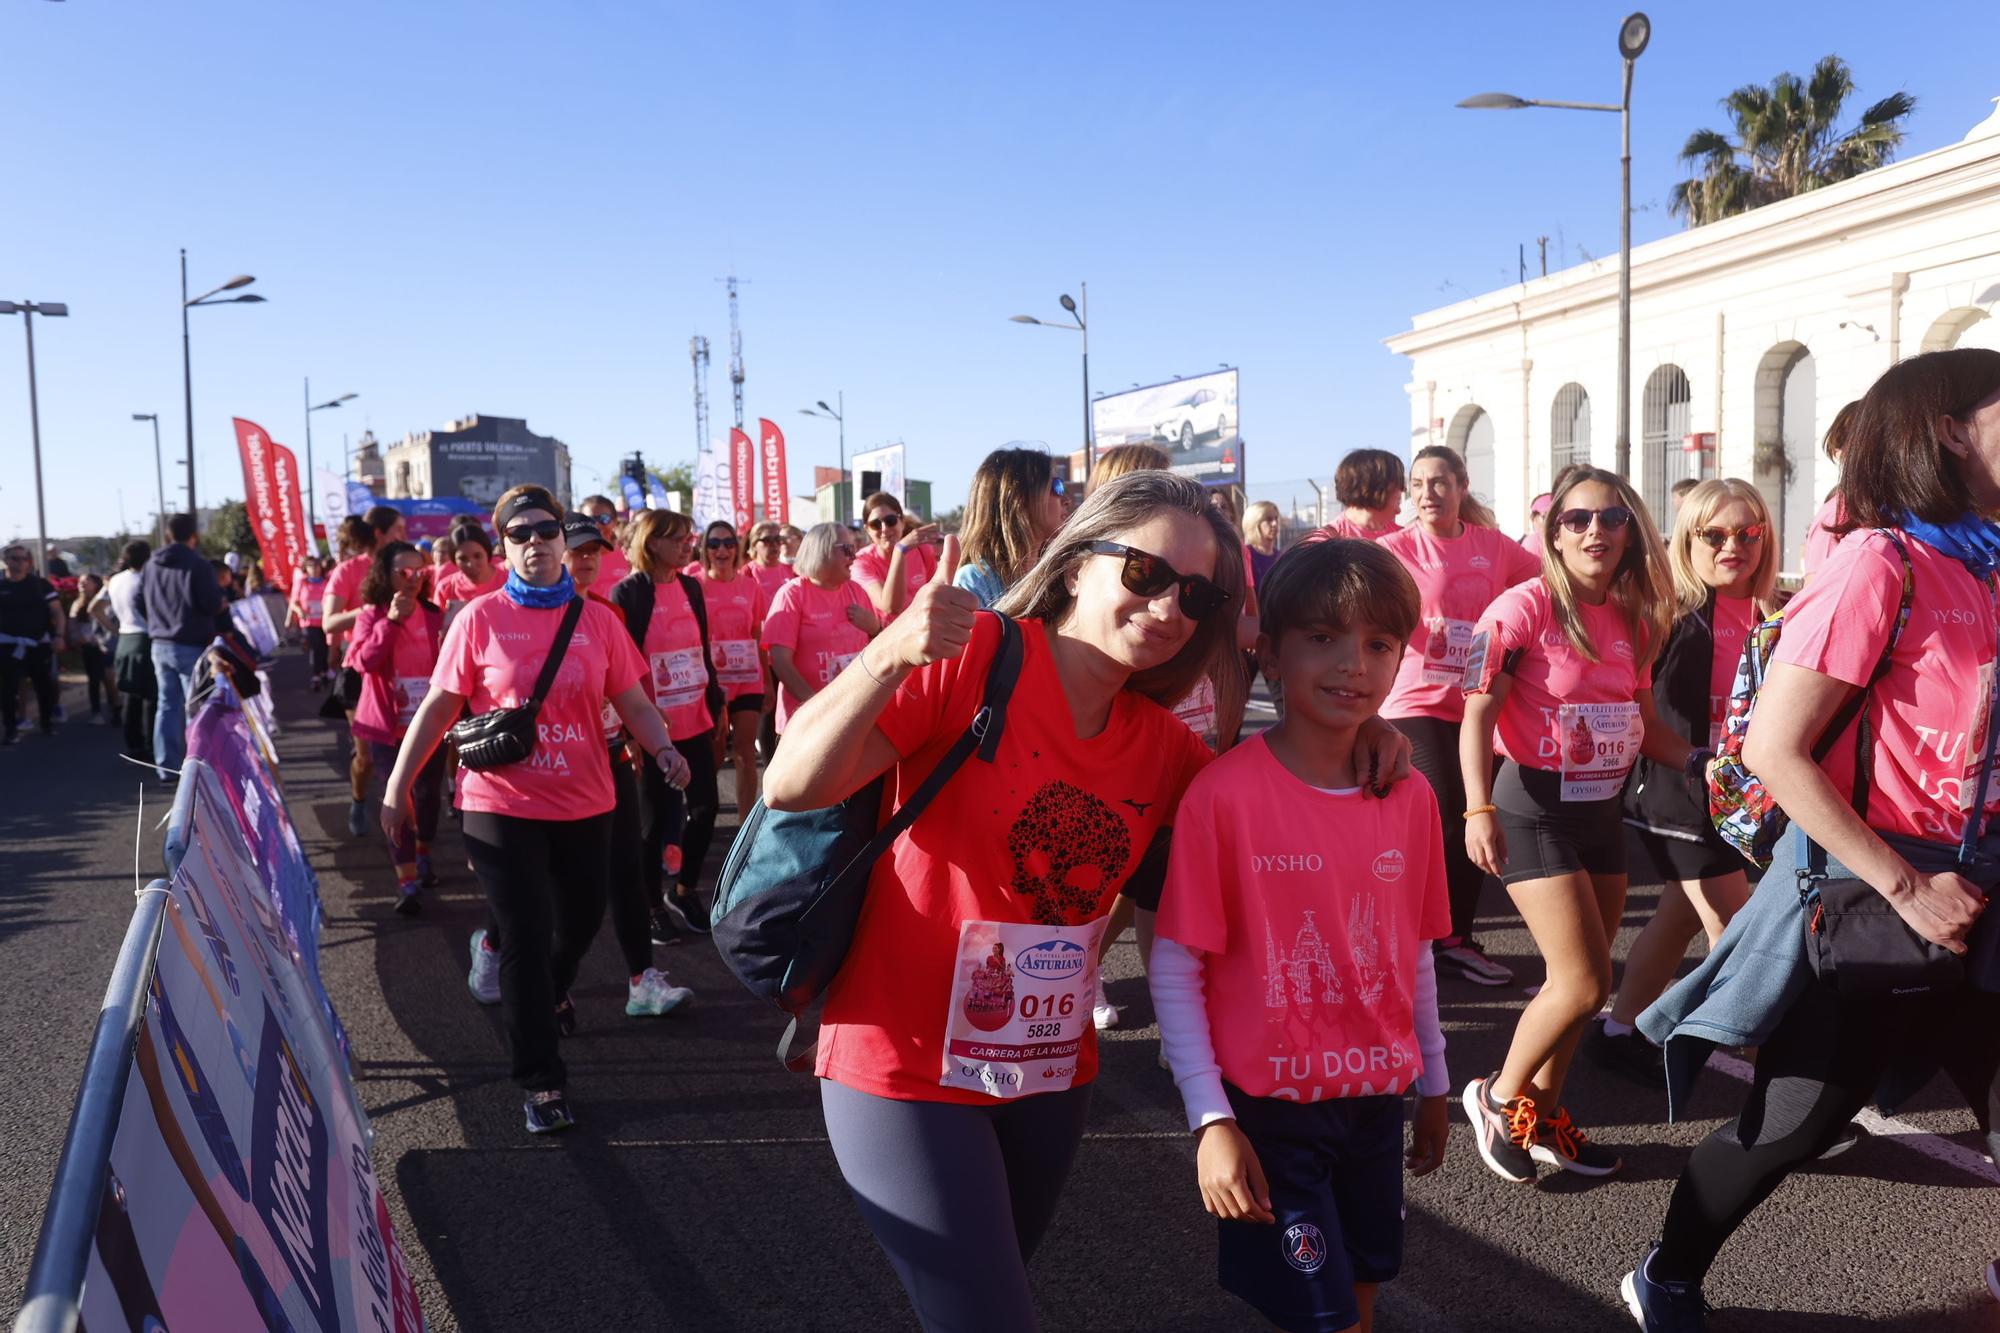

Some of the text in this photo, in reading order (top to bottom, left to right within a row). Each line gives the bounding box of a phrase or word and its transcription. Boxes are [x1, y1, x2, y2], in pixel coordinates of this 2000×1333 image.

[1578, 705, 1589, 713] LA
[538, 723, 585, 743] RSAL
[1597, 741, 1624, 755] 016
[1914, 725, 1965, 763] TU
[1571, 784, 1602, 794] OYSHO
[1021, 954, 1083, 970] ASTURIANA
[1019, 993, 1075, 1019] 016
[1027, 1022, 1061, 1039] 5828
[970, 1042, 1078, 1058] CARRERA DE LA MUJER
[961, 1065, 1019, 1086] OYSHO
[1268, 1055, 1310, 1080] TU
[1287, 1225, 1318, 1239] PARIS
